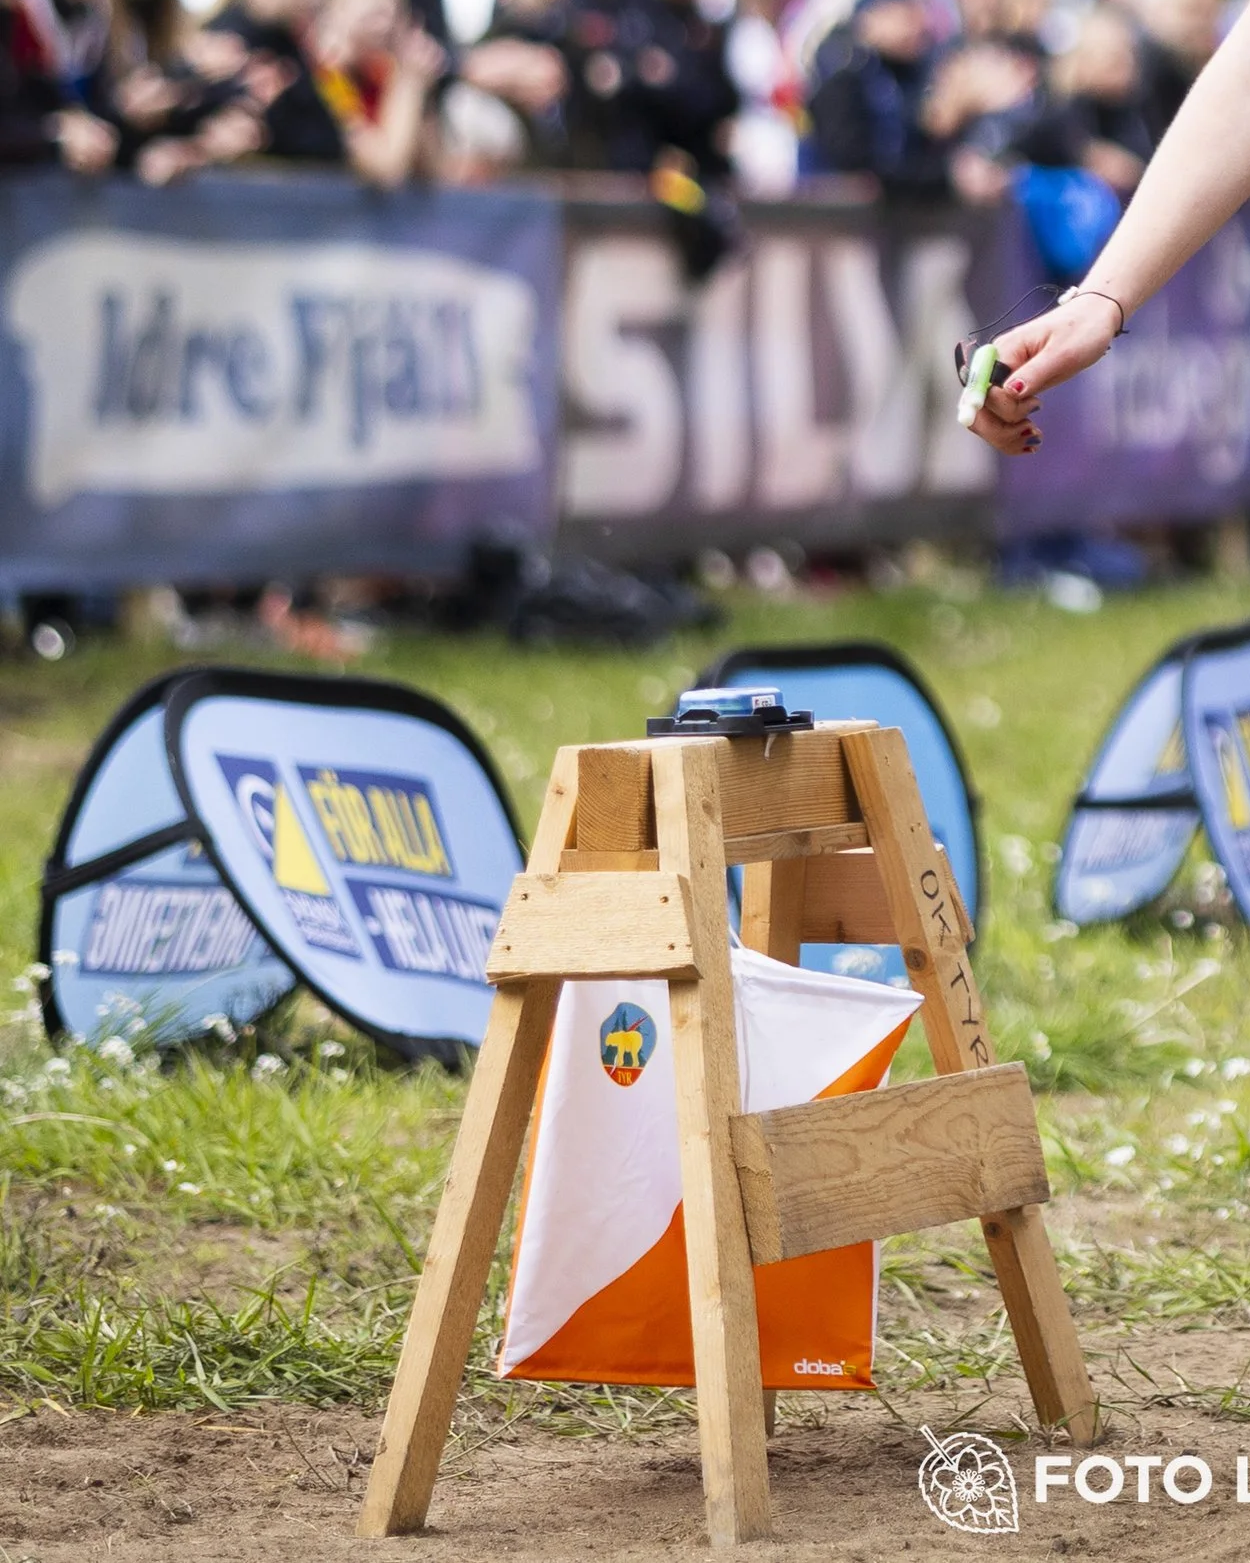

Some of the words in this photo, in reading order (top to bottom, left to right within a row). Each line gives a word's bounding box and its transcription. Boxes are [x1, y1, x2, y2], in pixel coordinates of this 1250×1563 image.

[366, 784, 452, 877] ALLA
[920, 869, 951, 947] OK
[950, 961, 989, 1068] TYR
[617, 1070, 633, 1085] TYR
